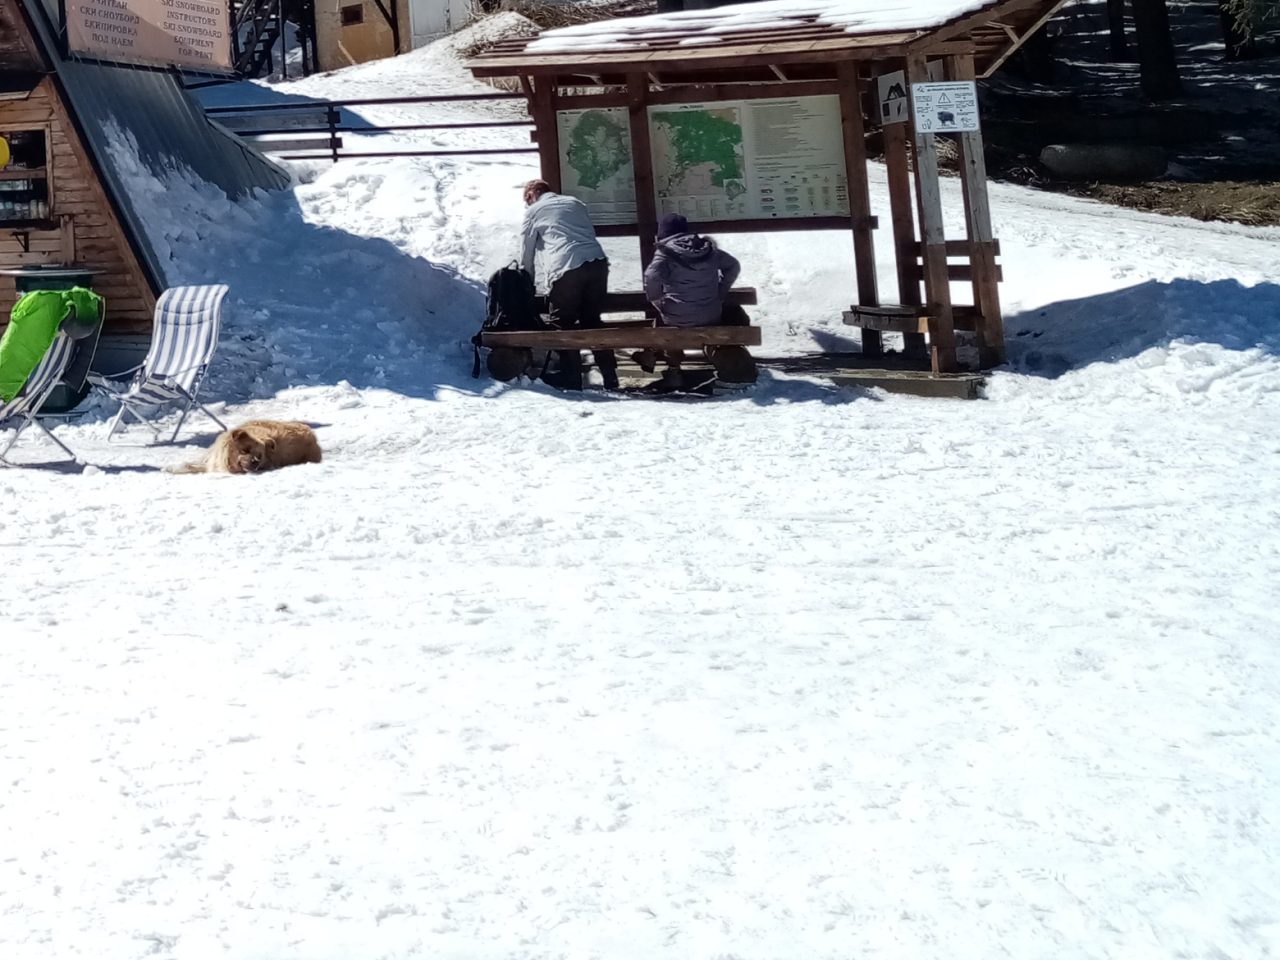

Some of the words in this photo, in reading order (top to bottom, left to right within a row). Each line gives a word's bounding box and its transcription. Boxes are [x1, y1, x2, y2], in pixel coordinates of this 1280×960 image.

[80, 6, 96, 17] СКИ
[98, 9, 140, 25] СНОУБОРД
[175, 0, 221, 16] SNOWBOARD
[166, 10, 217, 27] INSTRUCTORS
[85, 19, 138, 36] ЕКИПИРОВКА
[177, 24, 223, 39] SNOWBOARD
[92, 33, 109, 44] ПОД
[111, 36, 134, 47] НАЕМ
